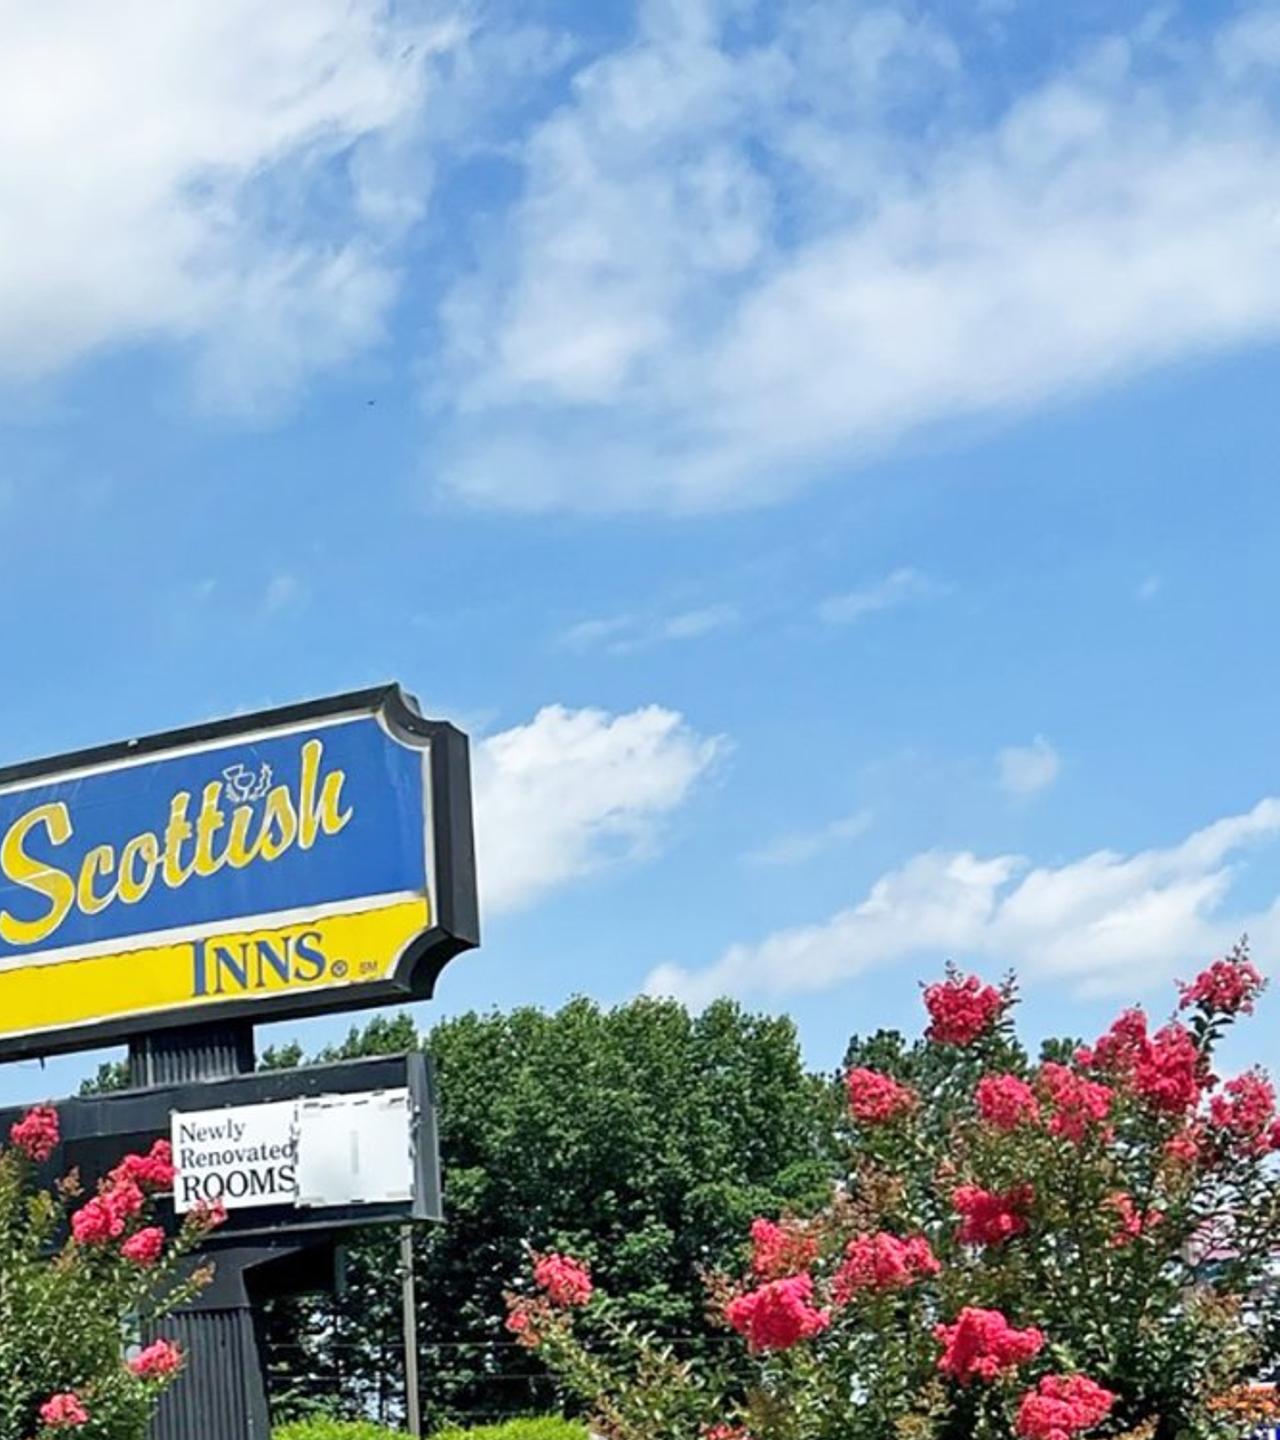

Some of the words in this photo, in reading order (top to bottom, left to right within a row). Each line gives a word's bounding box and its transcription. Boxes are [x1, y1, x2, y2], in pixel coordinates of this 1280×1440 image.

[192, 931, 326, 997] INNS
[179, 1118, 246, 1144] Newly
[180, 1138, 297, 1170] Renovated
[182, 1164, 297, 1201] ROOMS
